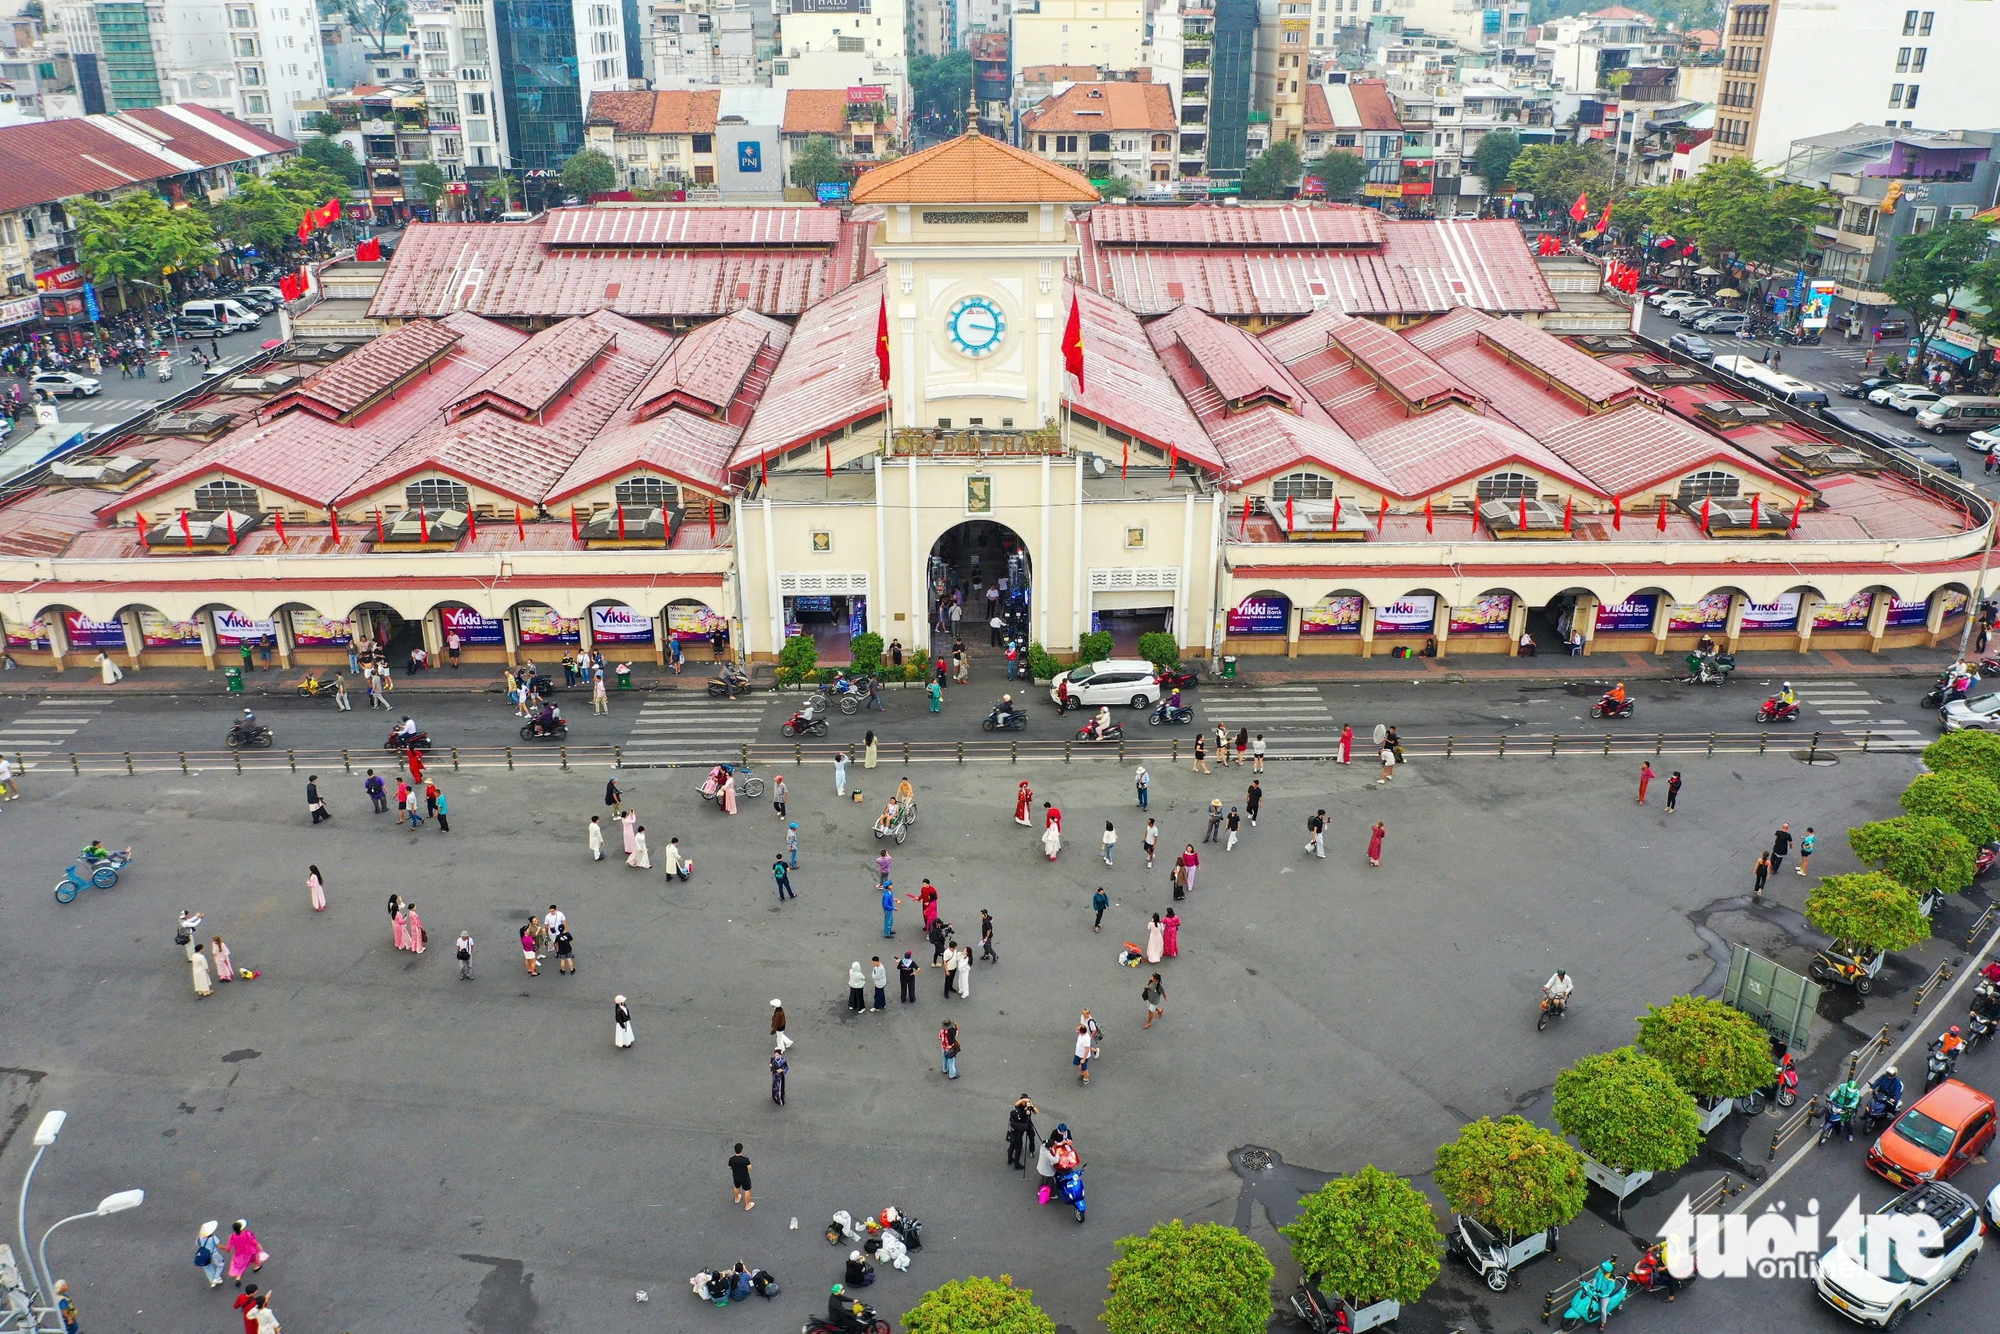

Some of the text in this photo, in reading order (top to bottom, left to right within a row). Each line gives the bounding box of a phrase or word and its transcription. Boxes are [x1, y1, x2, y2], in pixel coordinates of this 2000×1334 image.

[742, 157, 758, 168] PNJ
[218, 610, 253, 628] Vikki
[446, 608, 481, 625] Vikki
[596, 606, 631, 623] Vikki
